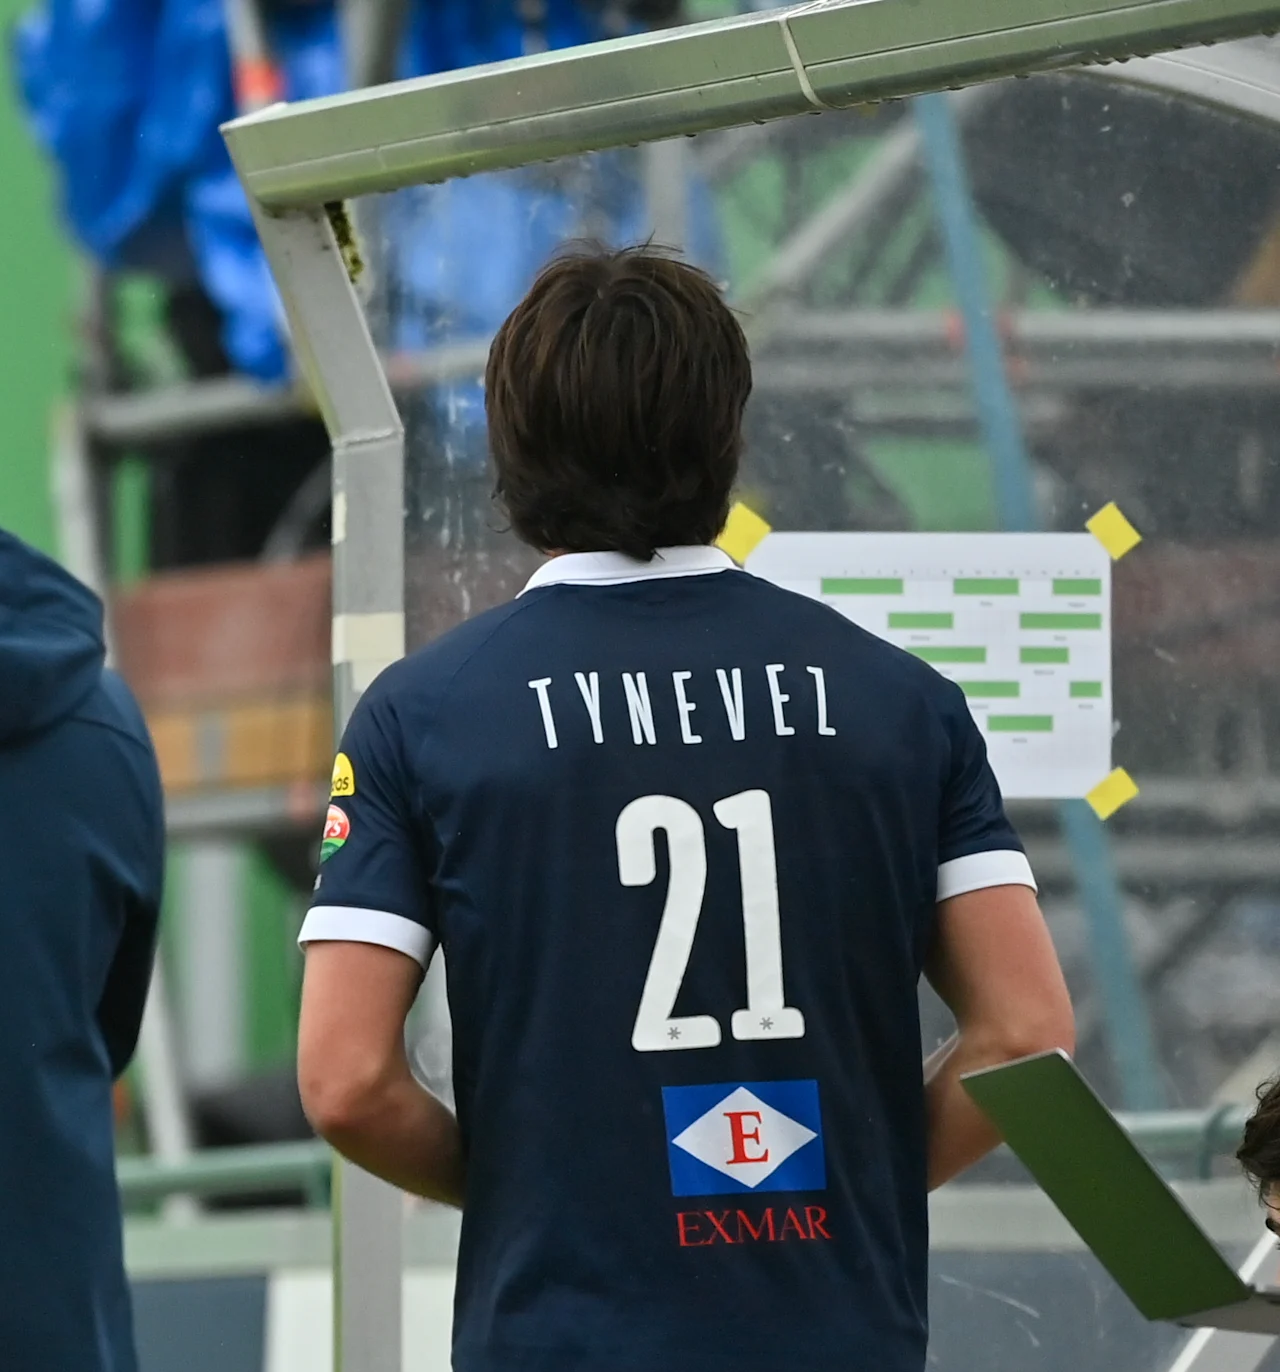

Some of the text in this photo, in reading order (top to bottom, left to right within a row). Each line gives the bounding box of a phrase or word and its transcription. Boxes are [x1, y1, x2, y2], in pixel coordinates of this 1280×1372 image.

[527, 663, 837, 749] TYNEVEZ
[615, 788, 806, 1052] 21
[723, 1111, 769, 1165] E
[676, 1204, 832, 1247] EXMAR
